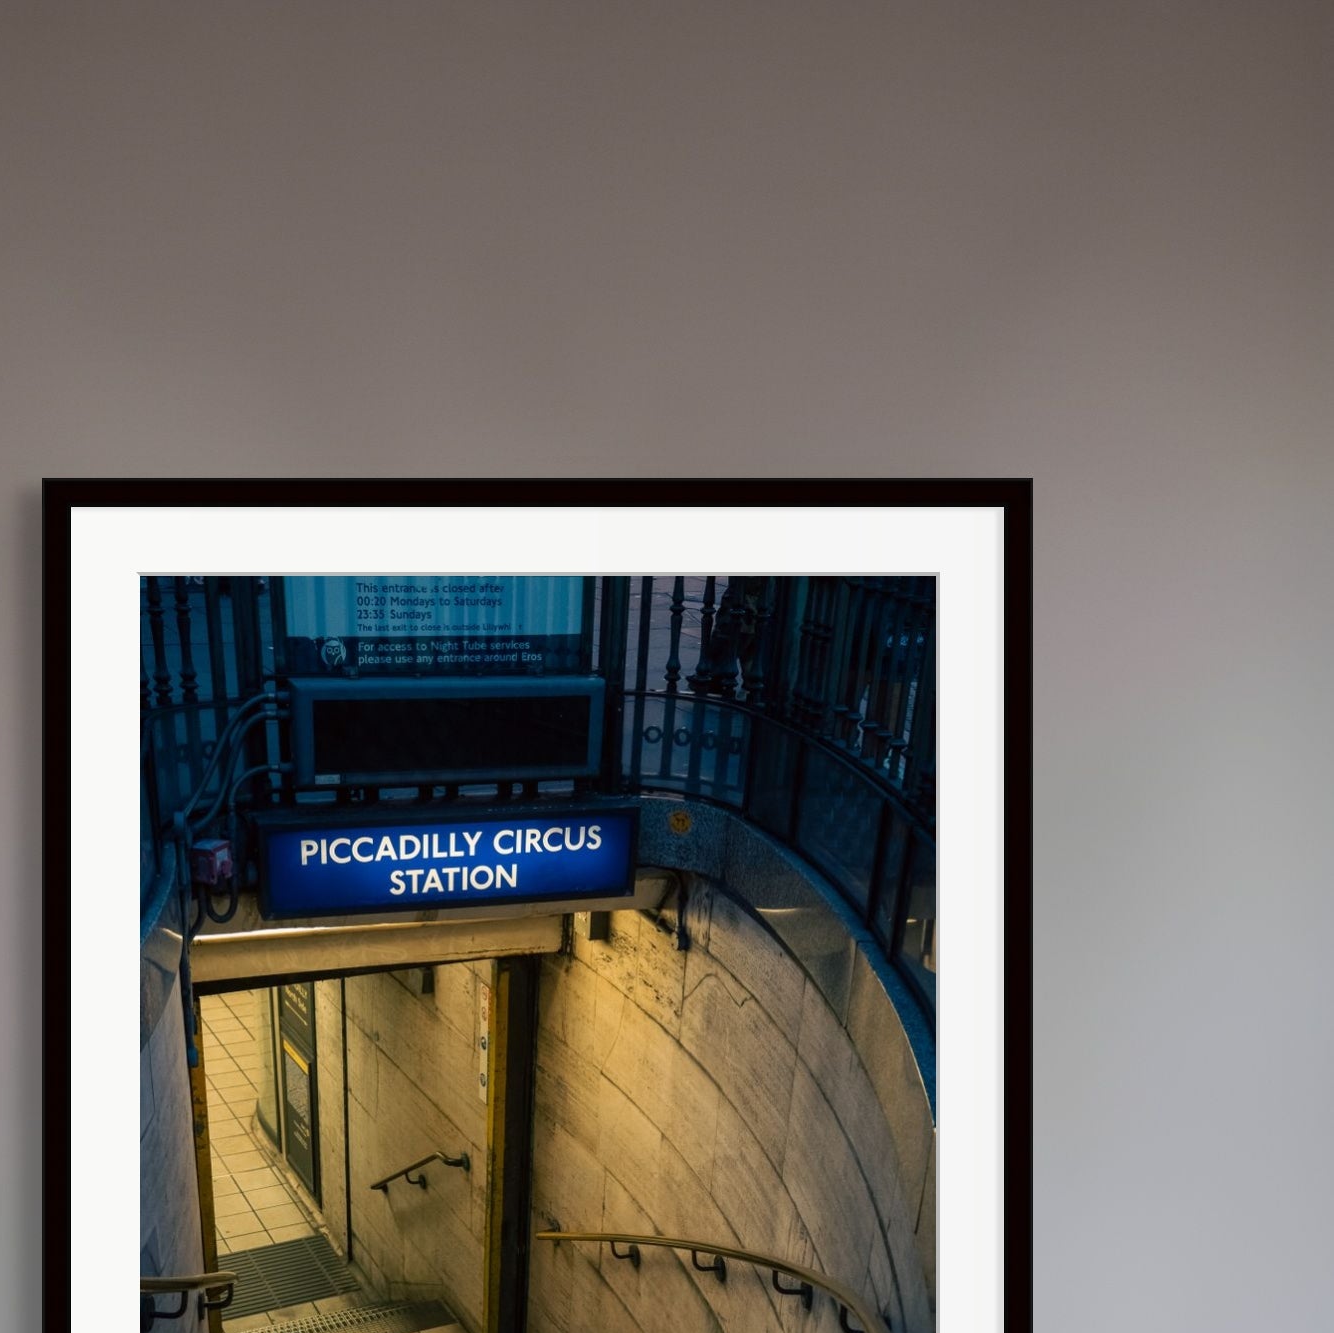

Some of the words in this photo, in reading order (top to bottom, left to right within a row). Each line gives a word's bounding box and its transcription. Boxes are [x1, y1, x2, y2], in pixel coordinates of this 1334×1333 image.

[356, 583, 379, 593] This
[442, 583, 476, 593] closed
[479, 582, 504, 593] after
[356, 597, 386, 607] 00:20
[390, 596, 435, 609] Mondays
[439, 597, 451, 607] to
[453, 596, 502, 609] Saturdays
[356, 610, 385, 620] 23:35
[390, 610, 432, 622] Sundays
[357, 624, 373, 632] The
[375, 624, 390, 632] last
[392, 624, 407, 632] exit
[409, 624, 419, 632] to
[420, 623, 442, 632] close
[358, 642, 374, 652] For
[377, 643, 413, 652] access
[416, 641, 428, 652] to
[430, 640, 459, 653] Night
[462, 640, 487, 651] Tube
[489, 639, 530, 650] services
[358, 654, 392, 667] please
[395, 655, 414, 663] use
[416, 655, 433, 665] any
[437, 653, 481, 663] entrance
[483, 651, 518, 662] around
[521, 650, 543, 662] Eros
[300, 832, 483, 866] PICCADILLY
[493, 825, 602, 855] CIRCUS
[389, 864, 518, 896] STATION
